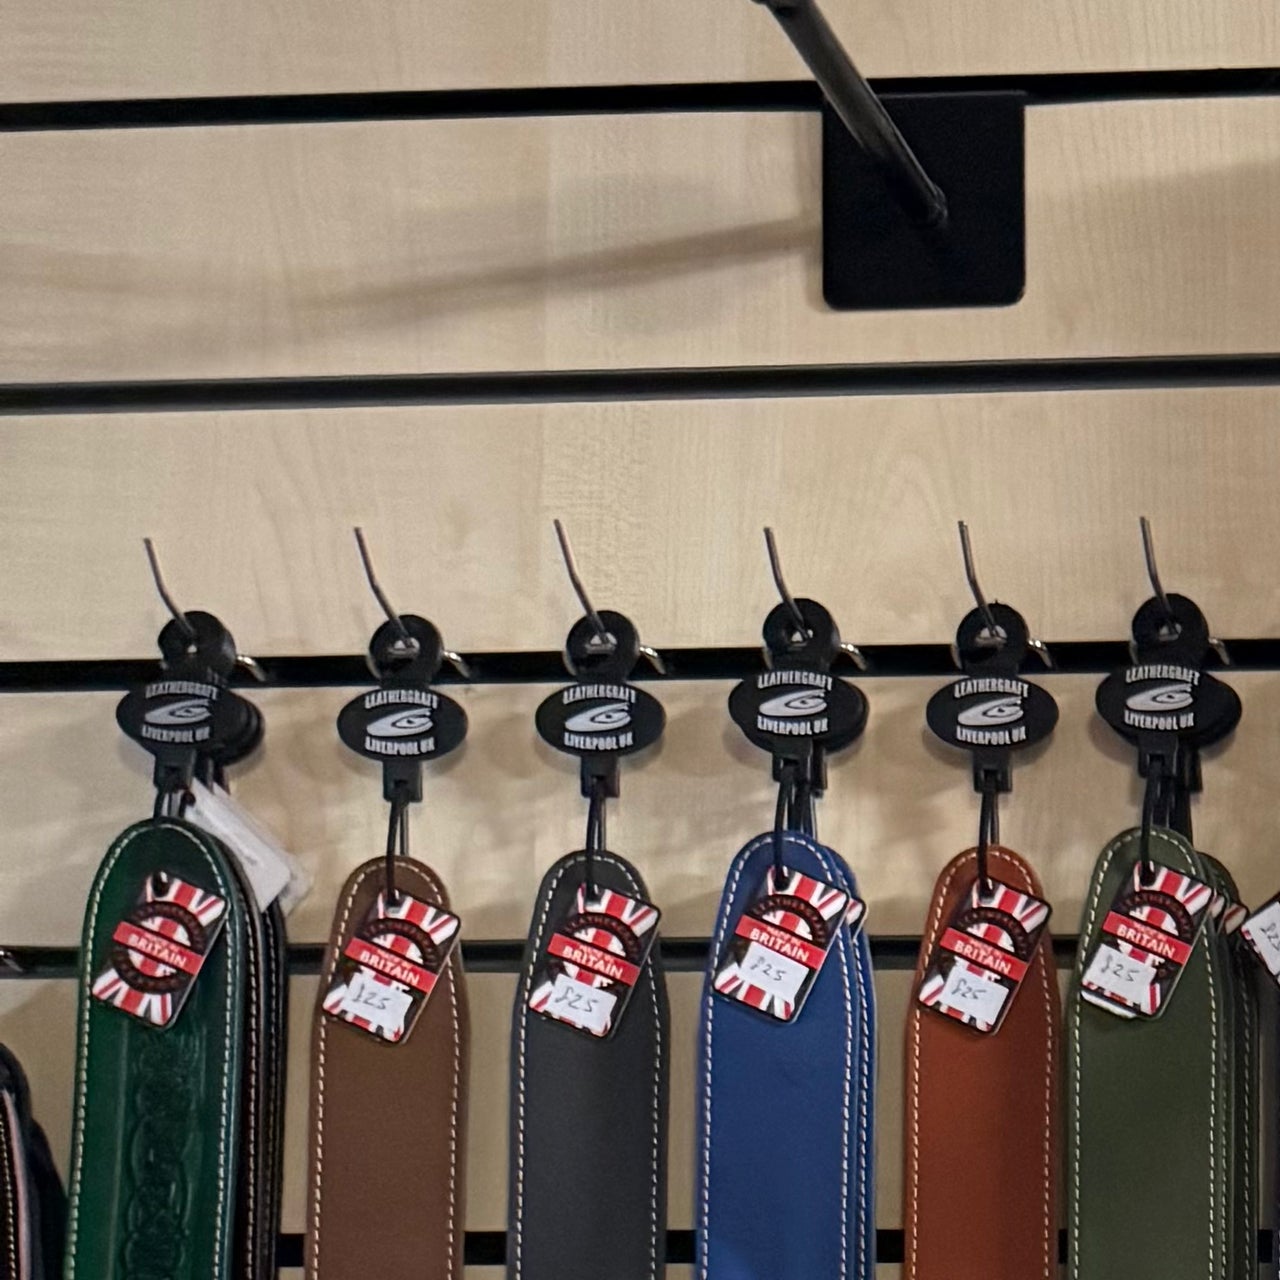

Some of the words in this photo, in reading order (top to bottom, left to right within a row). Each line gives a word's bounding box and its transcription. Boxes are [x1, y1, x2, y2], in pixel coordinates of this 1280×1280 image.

[757, 715, 812, 735] LIVERPOOL
[1124, 710, 1178, 730] LIVERPOOL
[142, 725, 194, 743] LIVERPOOL
[365, 736, 420, 755] LIVERPOOL
[564, 732, 618, 750] LIVERPOOL
[957, 726, 1010, 745] LIVERPOOL
[128, 934, 187, 967] BRITAIN
[750, 928, 809, 962] BRITAIN
[1117, 924, 1175, 958] BRITAIN
[360, 951, 420, 985] BRITAIN
[563, 946, 623, 978] BRITAIN
[955, 940, 1011, 974] BRITAIN
